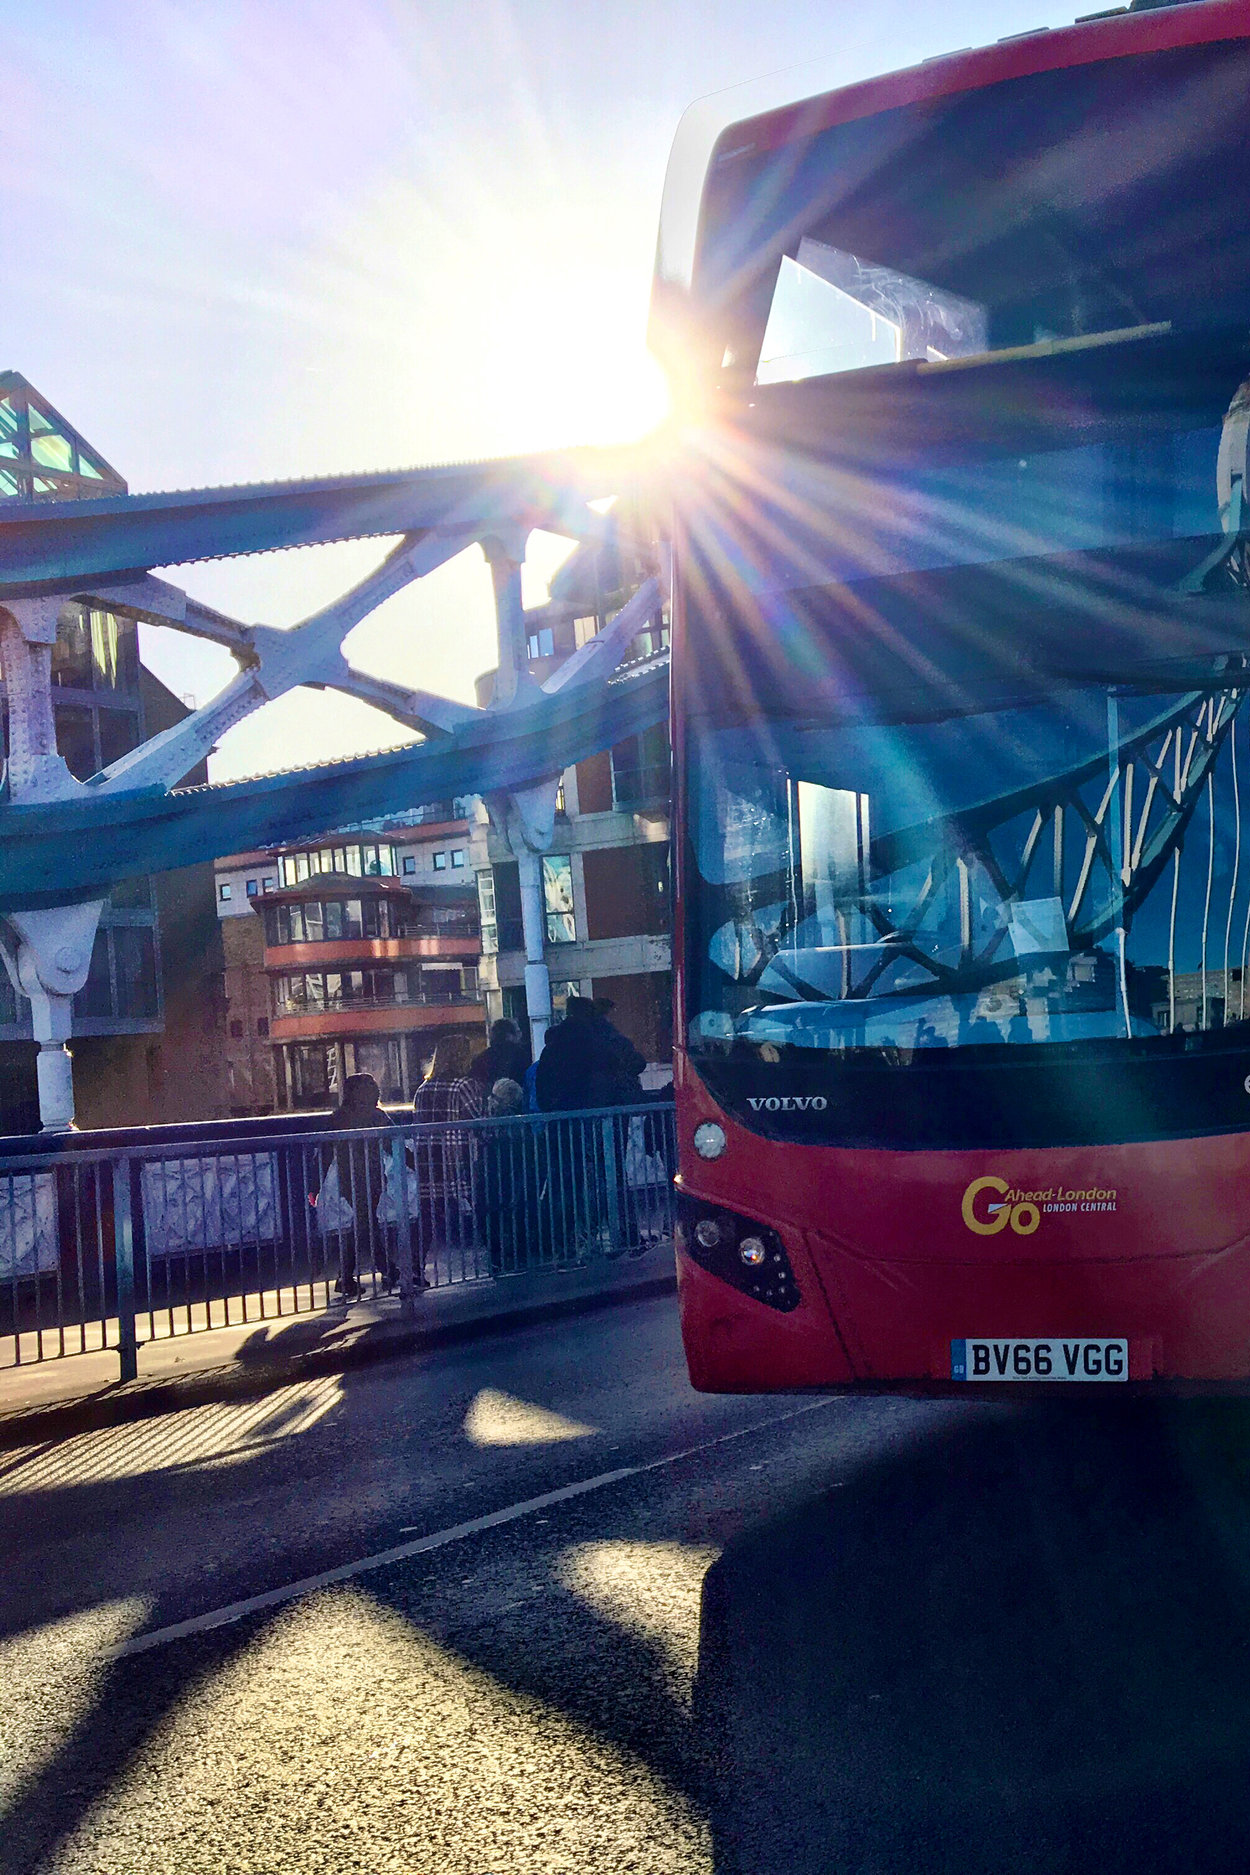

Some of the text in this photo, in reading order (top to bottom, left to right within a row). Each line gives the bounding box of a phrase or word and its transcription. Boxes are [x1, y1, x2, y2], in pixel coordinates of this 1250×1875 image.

[746, 1096, 828, 1111] VOLVO
[1004, 1187, 1117, 1202] Ahead-London
[962, 1176, 1040, 1235] Go
[1043, 1202, 1118, 1213] LONDON CENTRAL
[972, 1344, 1123, 1376] BV66 VGG
[953, 1364, 965, 1375] GB
